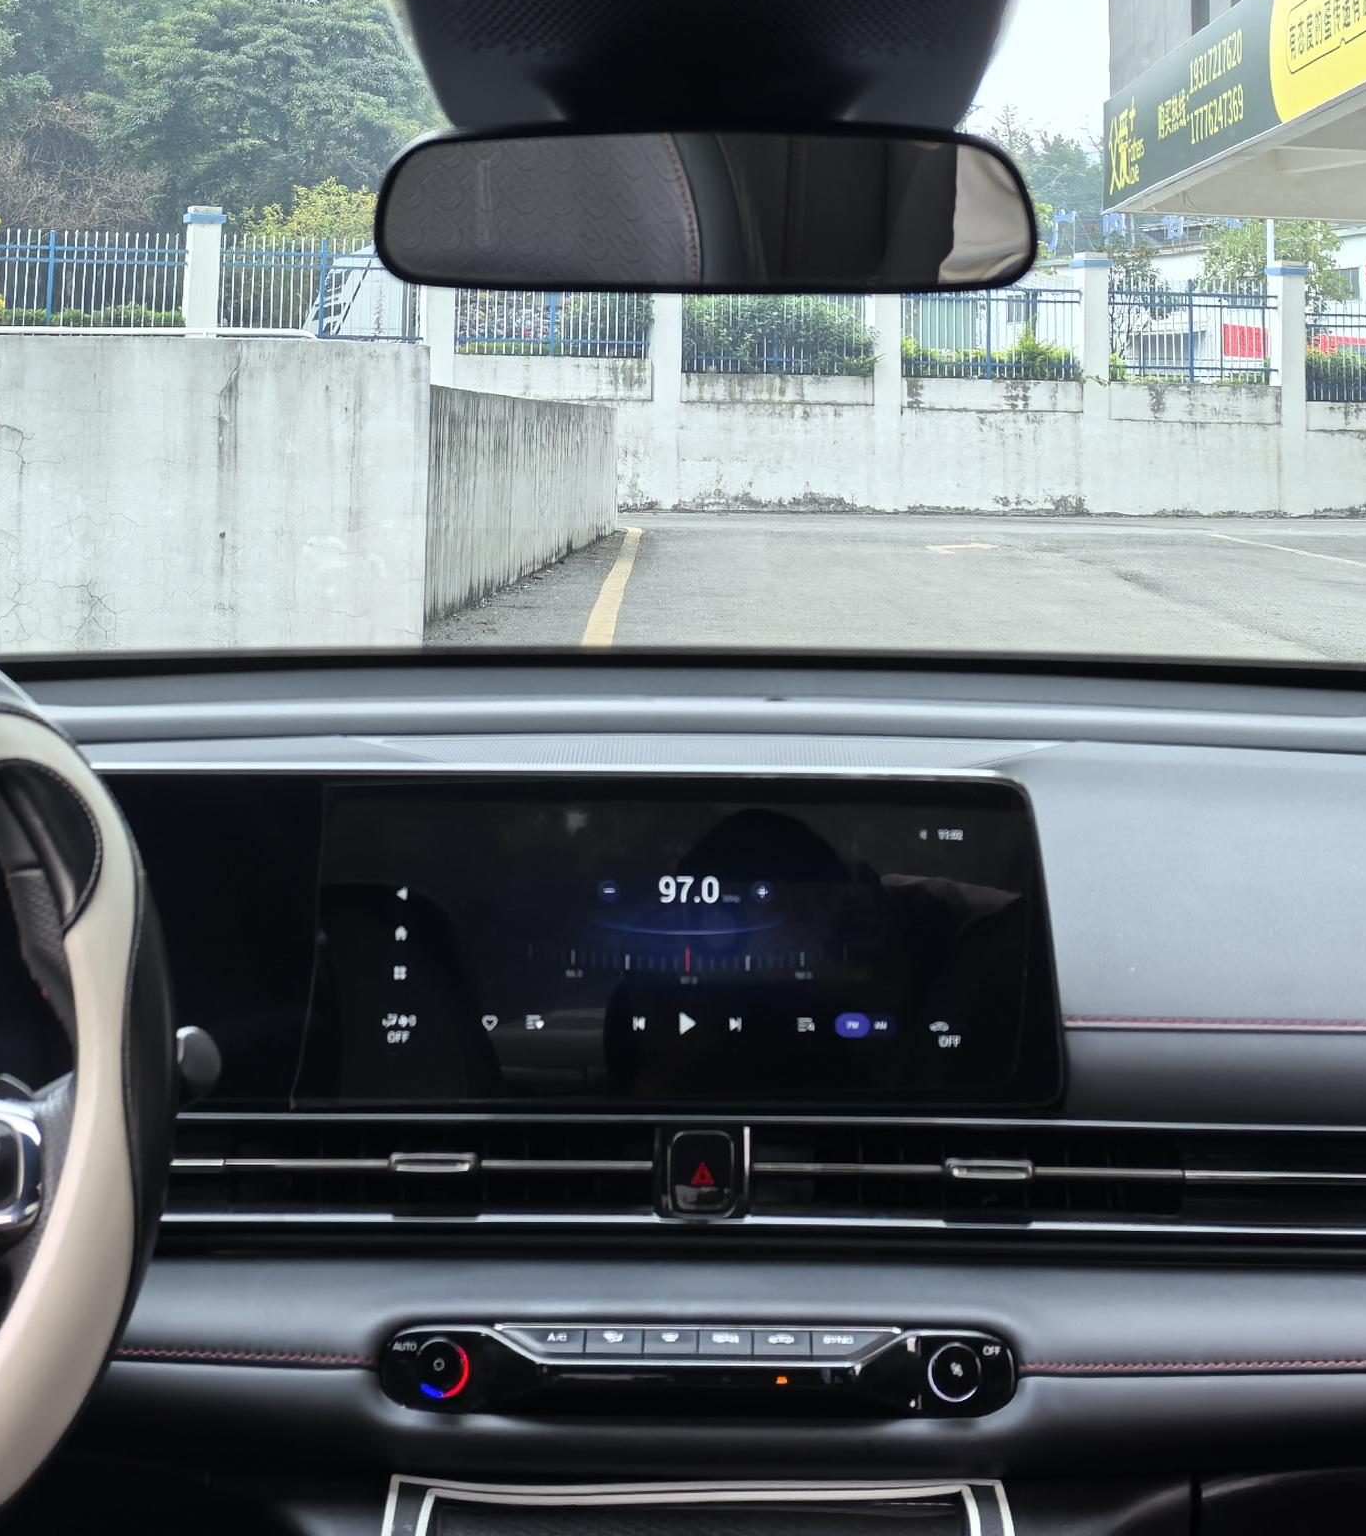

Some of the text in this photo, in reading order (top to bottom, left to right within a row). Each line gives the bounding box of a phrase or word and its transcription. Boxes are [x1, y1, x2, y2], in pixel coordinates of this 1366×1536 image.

[1189, 28, 1243, 94] 19317217620
[1190, 83, 1244, 145] 17776247369
[658, 875, 720, 904] 97.0
[387, 1030, 410, 1044] OFF
[938, 1034, 961, 1048] OFF
[392, 1341, 418, 1352] AUTO
[982, 1345, 1001, 1356] OFF
